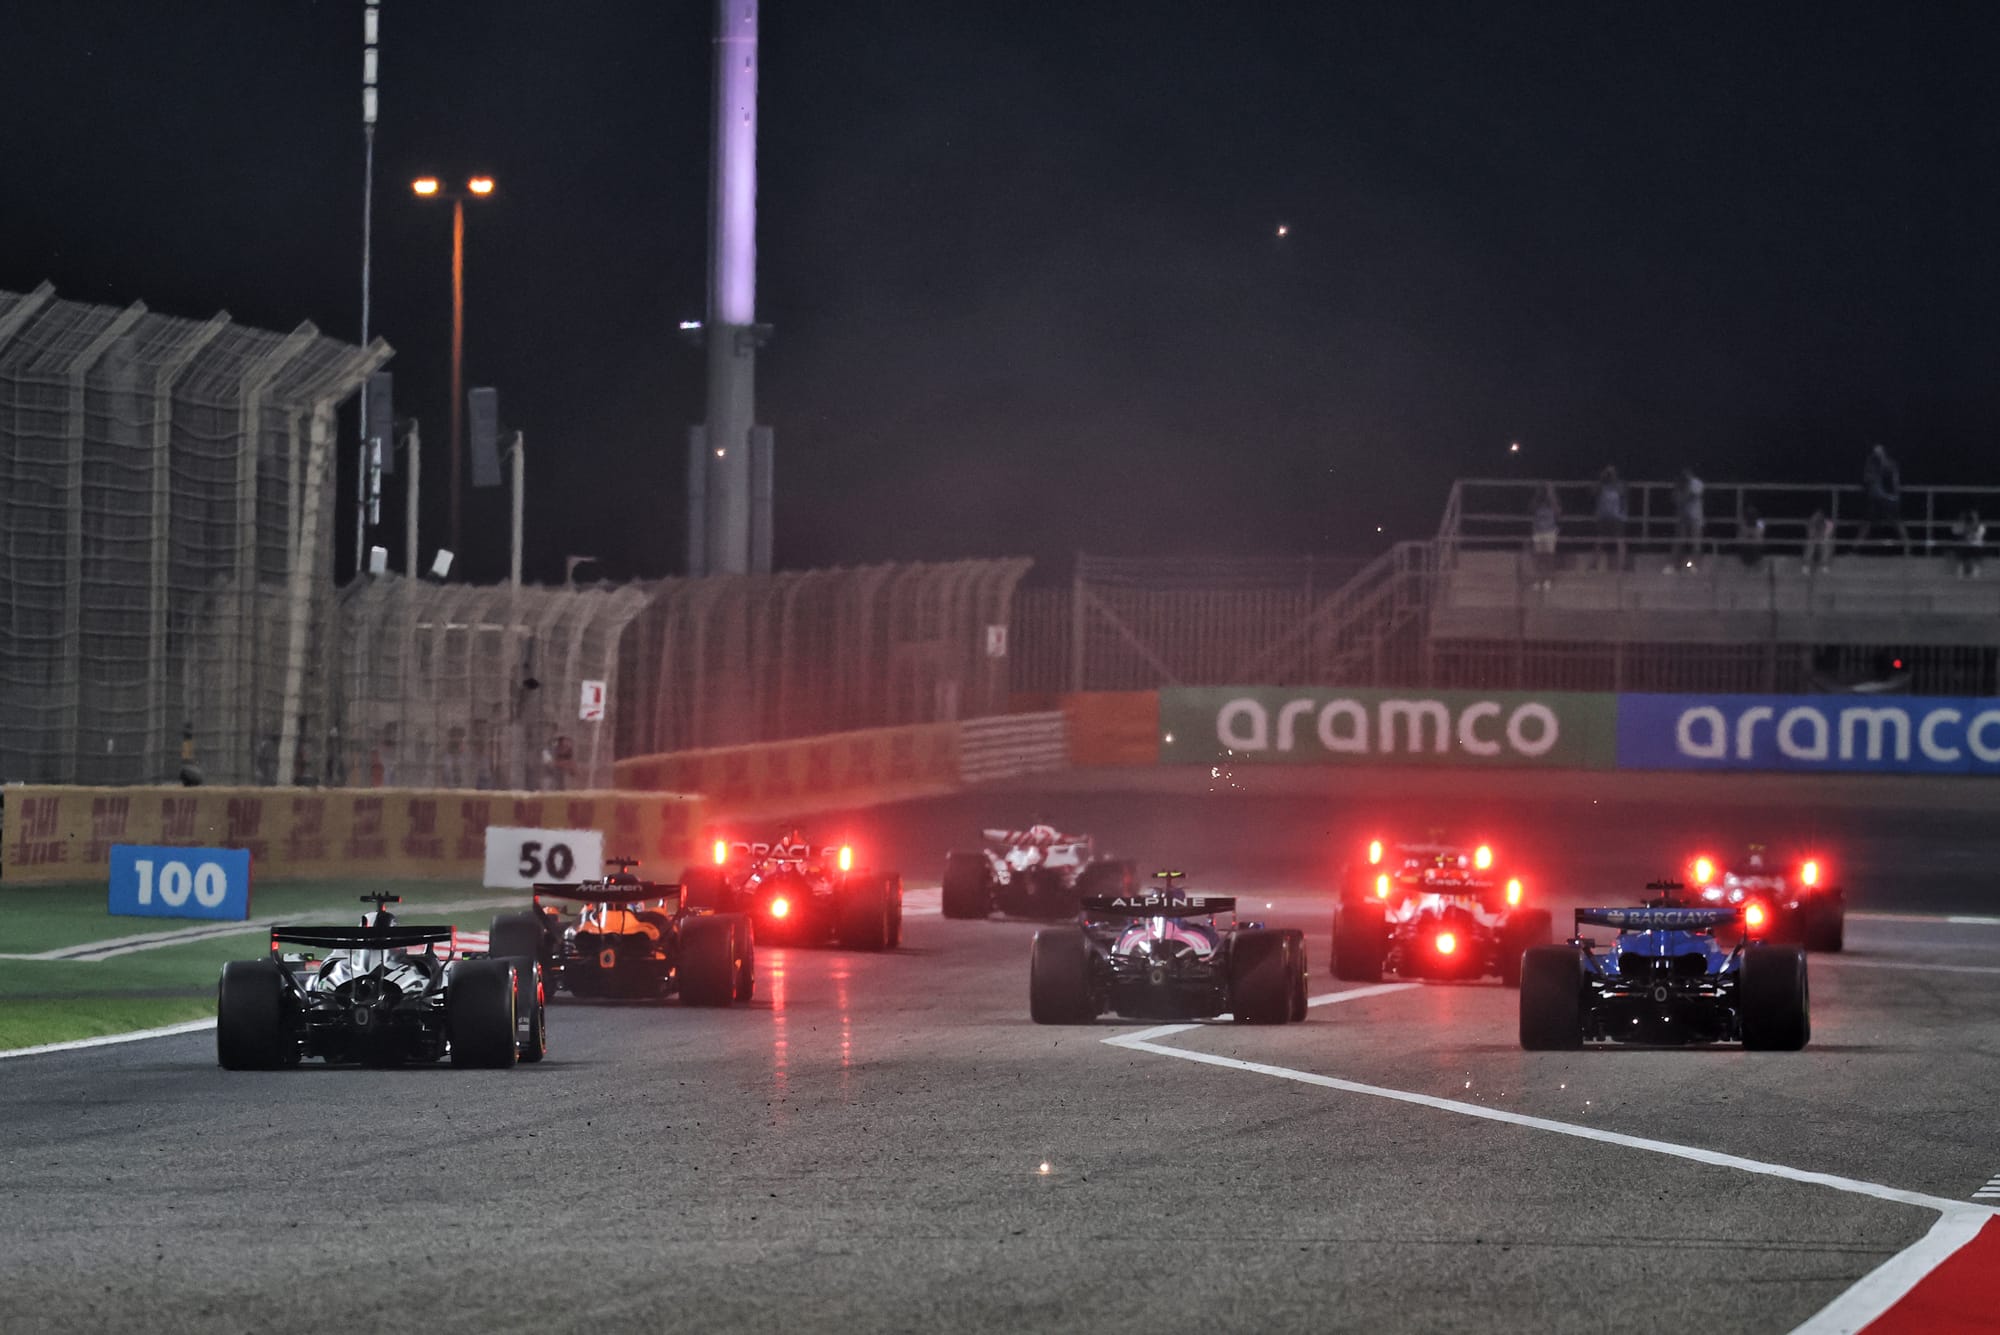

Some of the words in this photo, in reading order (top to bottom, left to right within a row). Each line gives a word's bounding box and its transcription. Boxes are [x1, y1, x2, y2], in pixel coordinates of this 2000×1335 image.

[1216, 698, 1560, 757] aramco
[1676, 706, 2000, 762] aramco
[518, 841, 574, 880] 50
[134, 859, 227, 908] 100
[575, 883, 644, 893] McLaren
[1111, 897, 1206, 908] ALPINE
[1628, 910, 1718, 926] BARCLAYS
